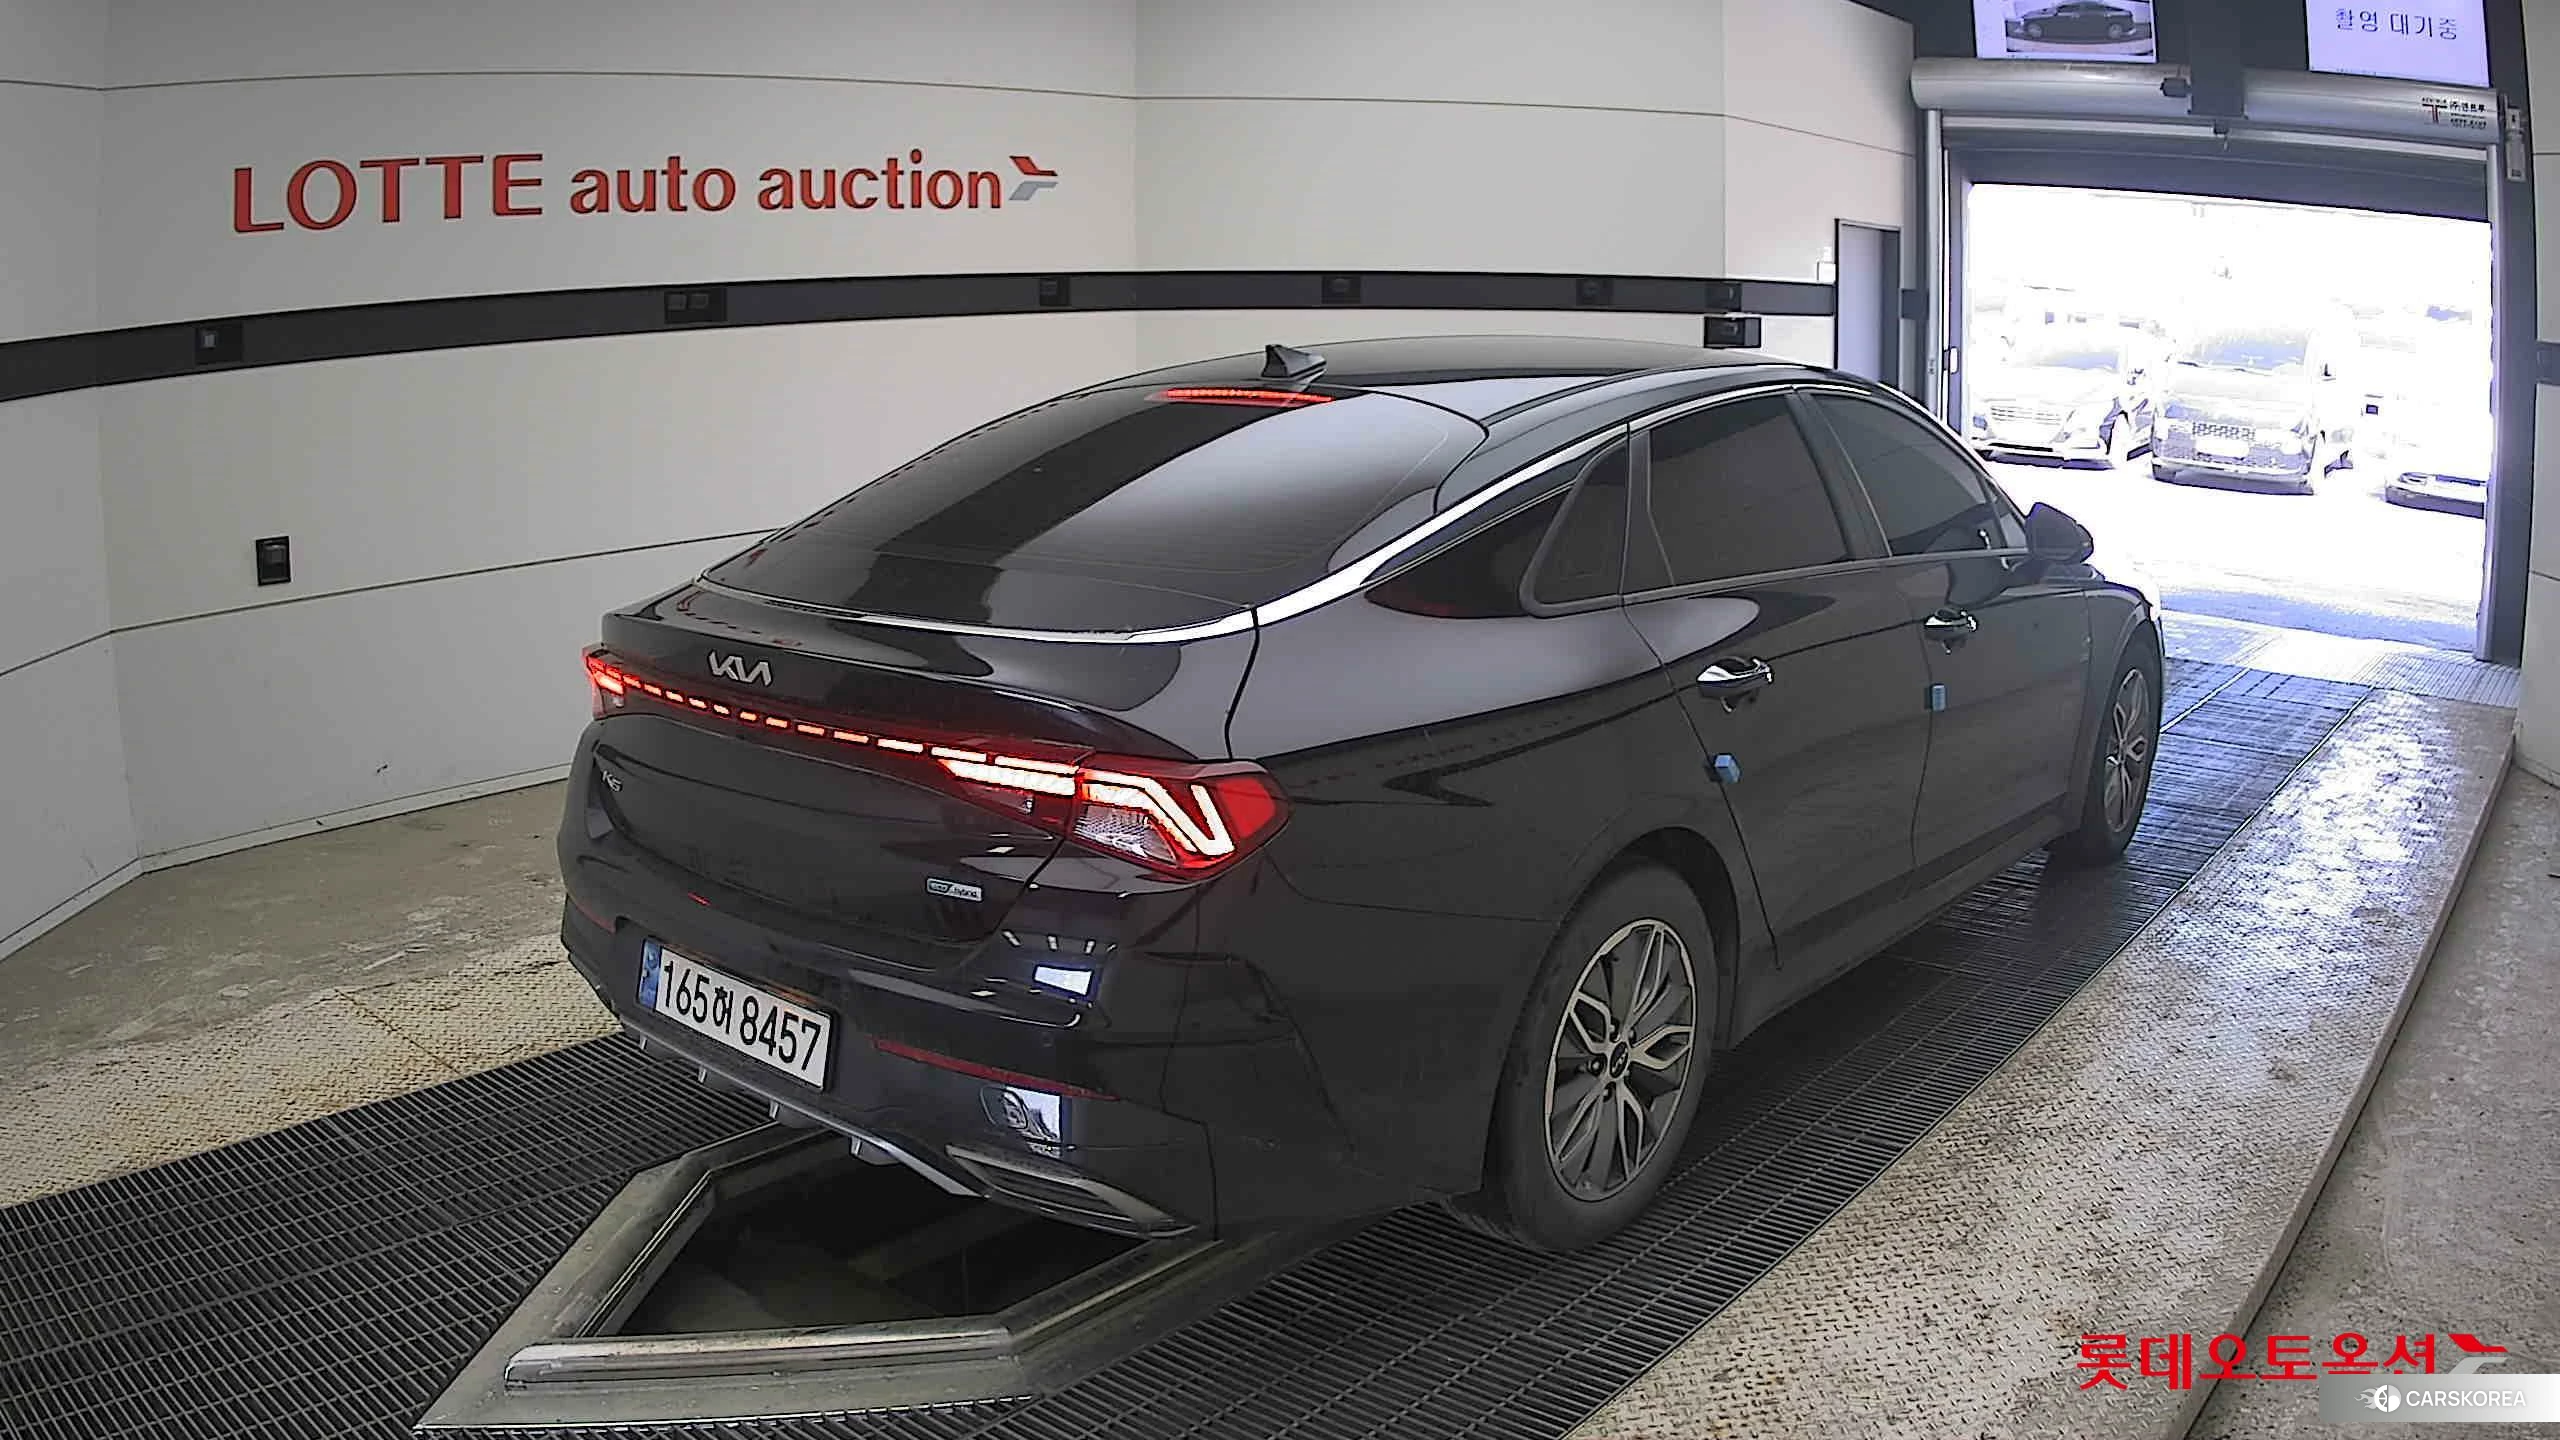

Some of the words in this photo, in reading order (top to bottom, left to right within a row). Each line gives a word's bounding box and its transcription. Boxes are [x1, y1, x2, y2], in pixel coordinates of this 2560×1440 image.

[2335, 8, 2379, 33] 촬영
[233, 153, 544, 233] LOTTE
[569, 155, 737, 214] auto
[757, 148, 1003, 210] auction
[708, 651, 772, 687] KIA
[739, 995, 822, 1072] 8457
